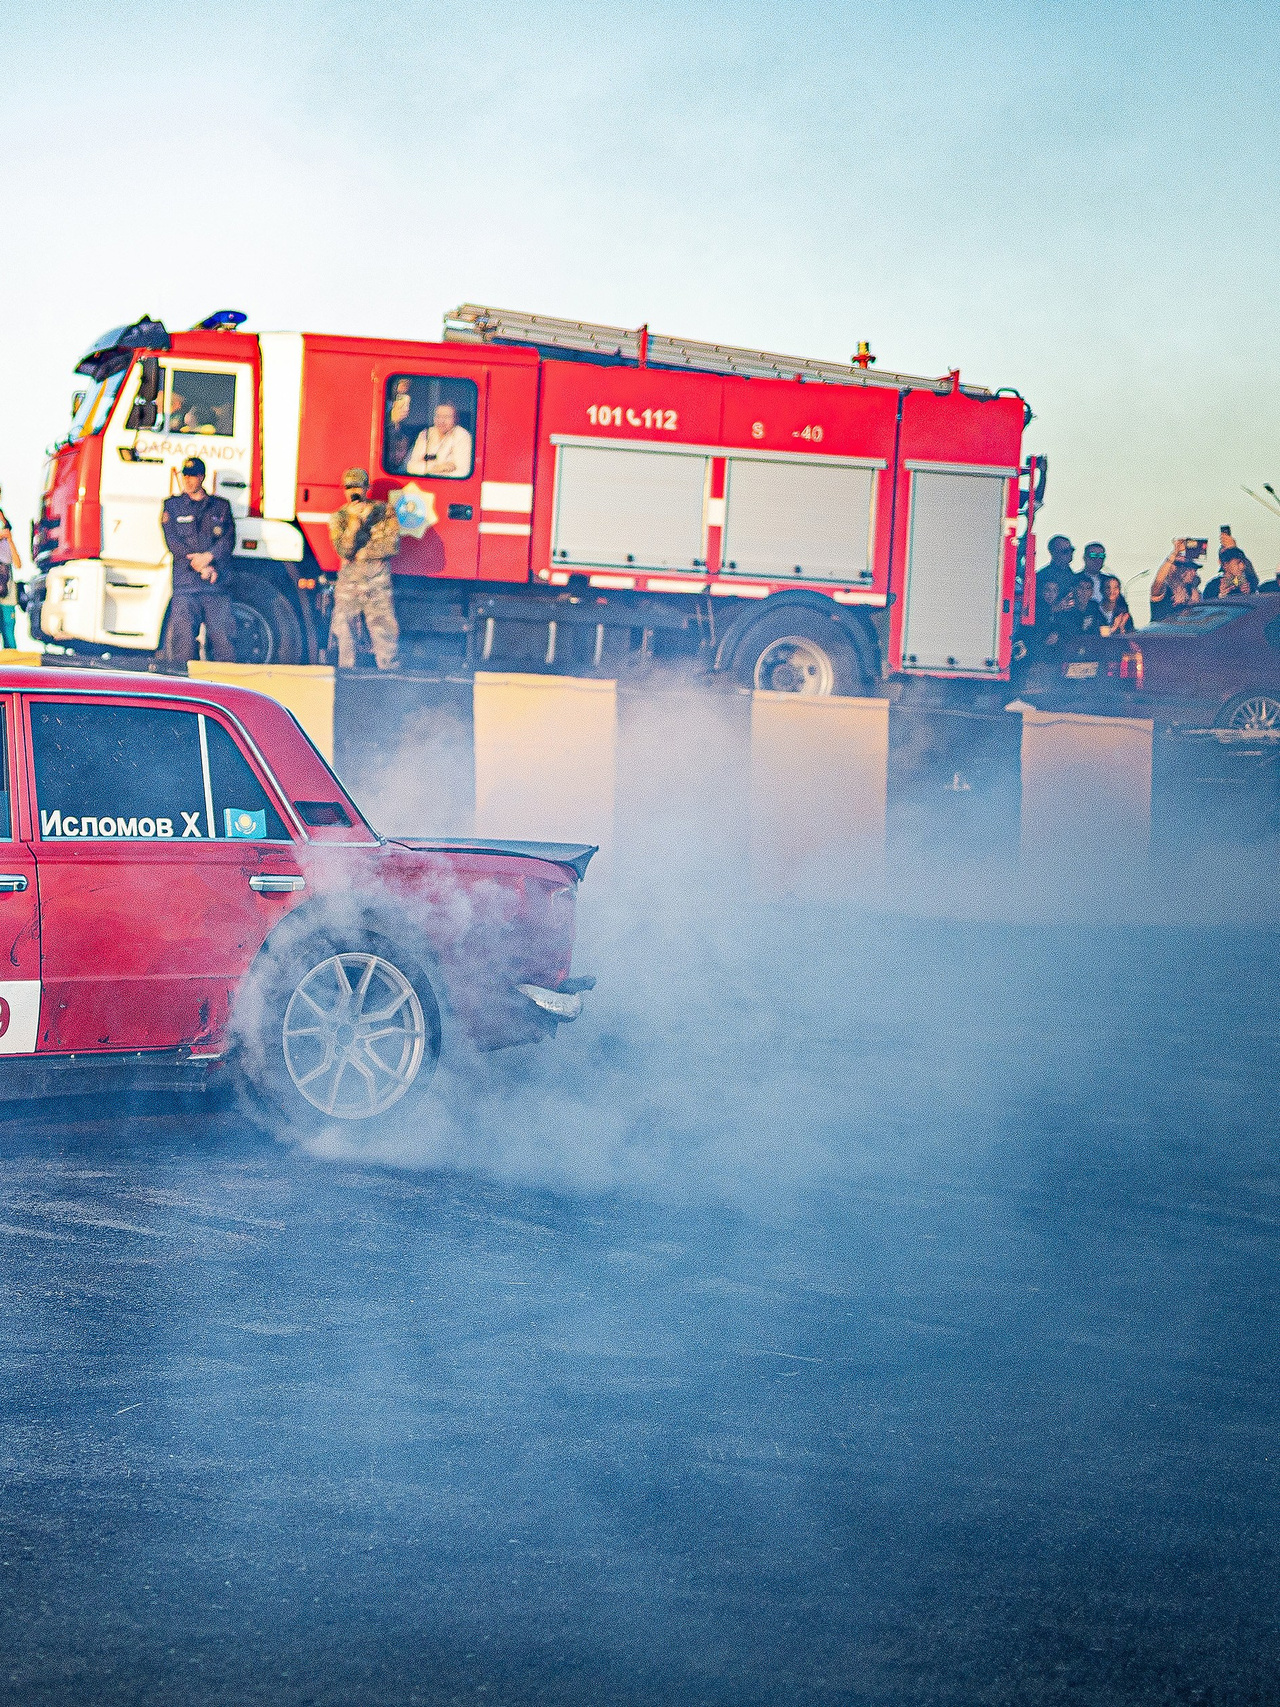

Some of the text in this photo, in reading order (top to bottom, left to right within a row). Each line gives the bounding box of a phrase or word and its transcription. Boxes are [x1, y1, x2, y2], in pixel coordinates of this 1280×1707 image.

[586, 404, 678, 431] 101 112
[41, 809, 174, 837] Исломов
